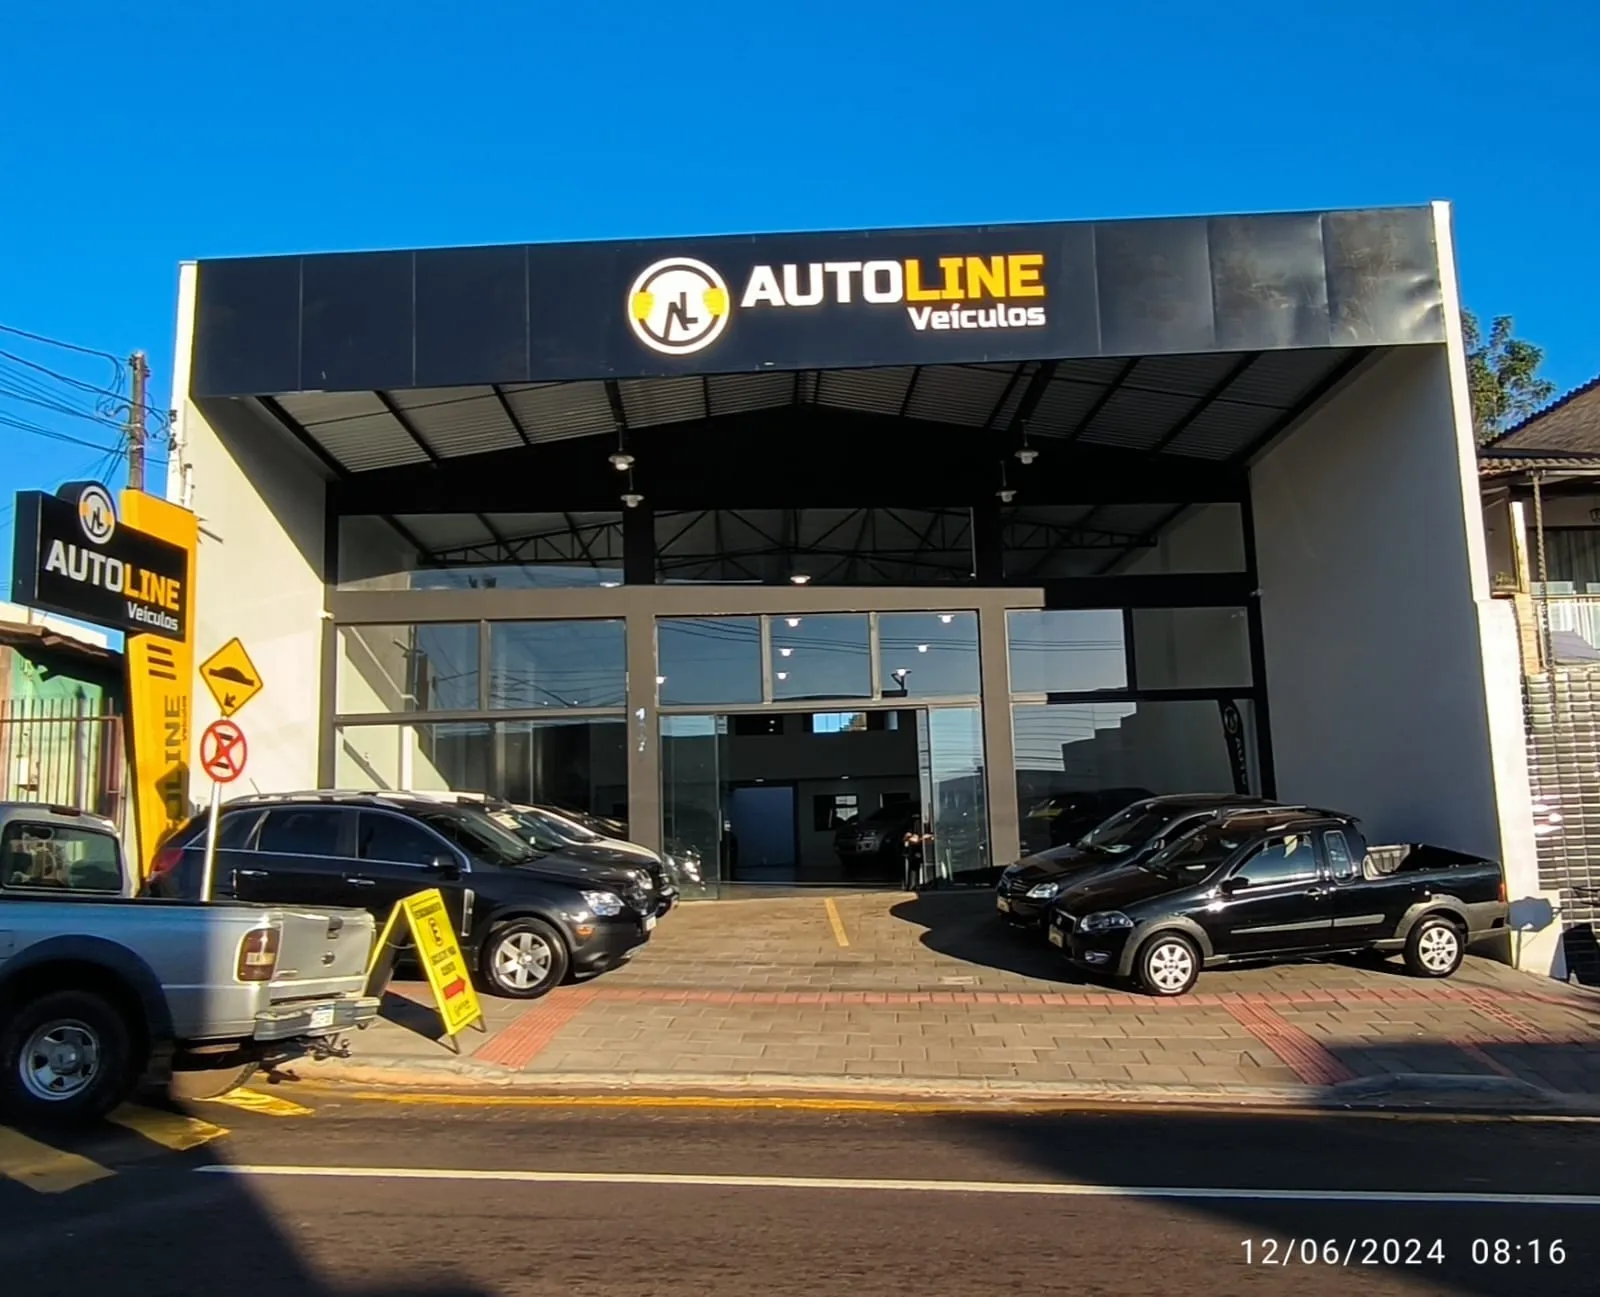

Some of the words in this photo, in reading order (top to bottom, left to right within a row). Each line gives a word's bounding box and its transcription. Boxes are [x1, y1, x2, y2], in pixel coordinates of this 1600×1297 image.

[740, 254, 1045, 308] AUTOLINE
[907, 302, 1047, 331] Veículos
[45, 539, 180, 611] AUTOLINE
[127, 601, 178, 631] Veículos
